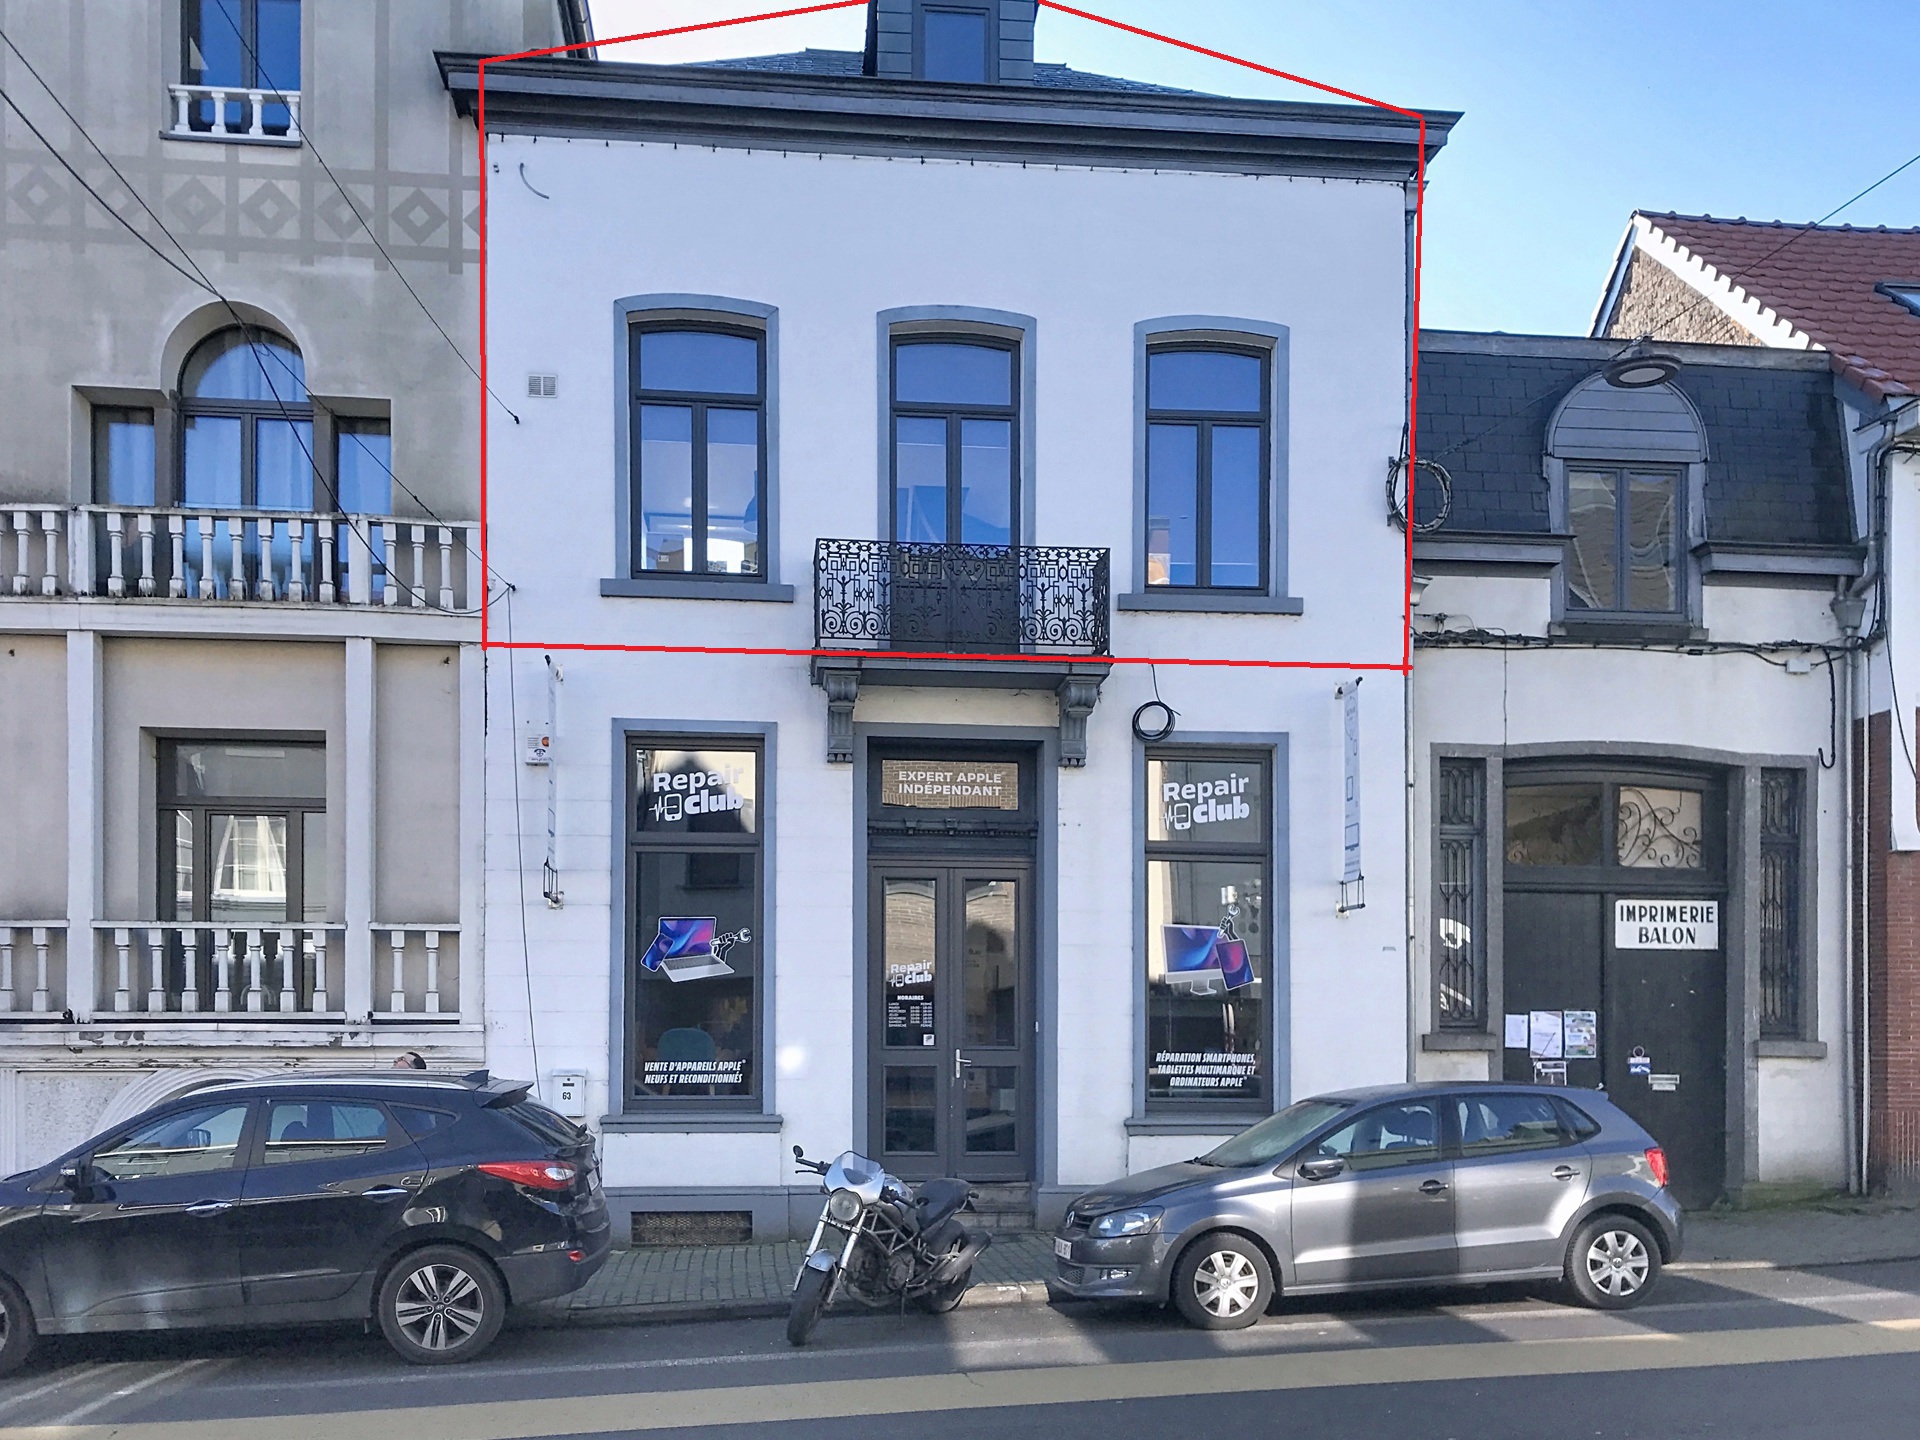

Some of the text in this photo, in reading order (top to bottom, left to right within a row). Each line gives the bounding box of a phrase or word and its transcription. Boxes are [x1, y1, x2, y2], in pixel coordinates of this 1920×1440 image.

[653, 763, 744, 794] Repair
[899, 771, 953, 782] EXPERT
[899, 781, 1002, 796] INDÉPENDANT
[1163, 772, 1249, 803] Repair
[684, 787, 744, 814] club
[1193, 796, 1250, 824] club
[1620, 905, 1714, 923] IMPRIMERIE
[1638, 927, 1697, 944] BALON
[891, 959, 932, 974] Repair
[905, 970, 933, 984] club
[1156, 1050, 1202, 1062] RÉPARATION
[644, 1061, 669, 1072] VENTE
[668, 1061, 717, 1072] D'APPAREILS
[1157, 1064, 1256, 1076] TABLETTES MULTIMARQUE ET
[644, 1071, 743, 1084] NEUFS ET RECONDITIONNÉS
[1170, 1076, 1219, 1087] ORDINATEURS
[562, 1091, 572, 1101] 63
